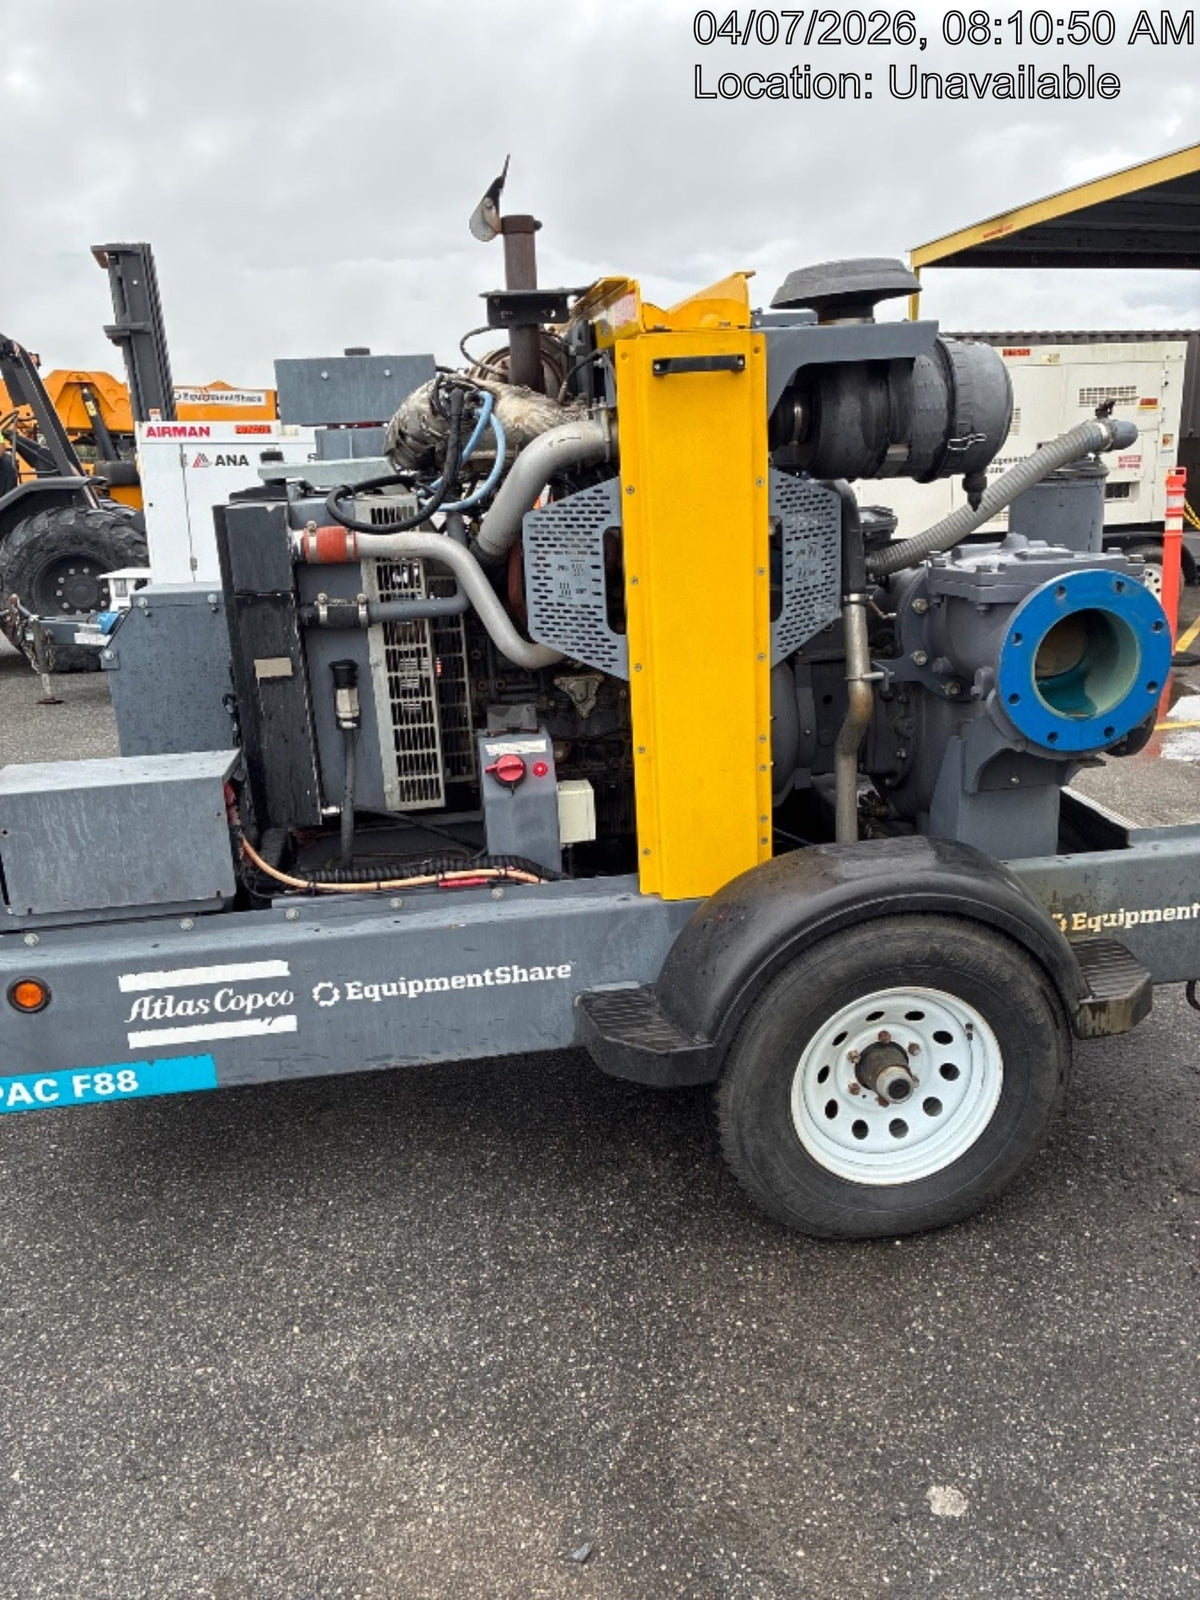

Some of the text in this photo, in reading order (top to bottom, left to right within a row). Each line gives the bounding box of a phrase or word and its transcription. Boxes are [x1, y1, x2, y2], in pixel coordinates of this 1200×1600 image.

[146, 425, 211, 438] AIRMAN
[215, 454, 250, 467] ANA
[1072, 902, 1200, 933] Equipment
[345, 963, 572, 1002] EquipmentShare
[124, 987, 294, 1023] Atlas Copco
[0, 1069, 139, 1107] AC F88
